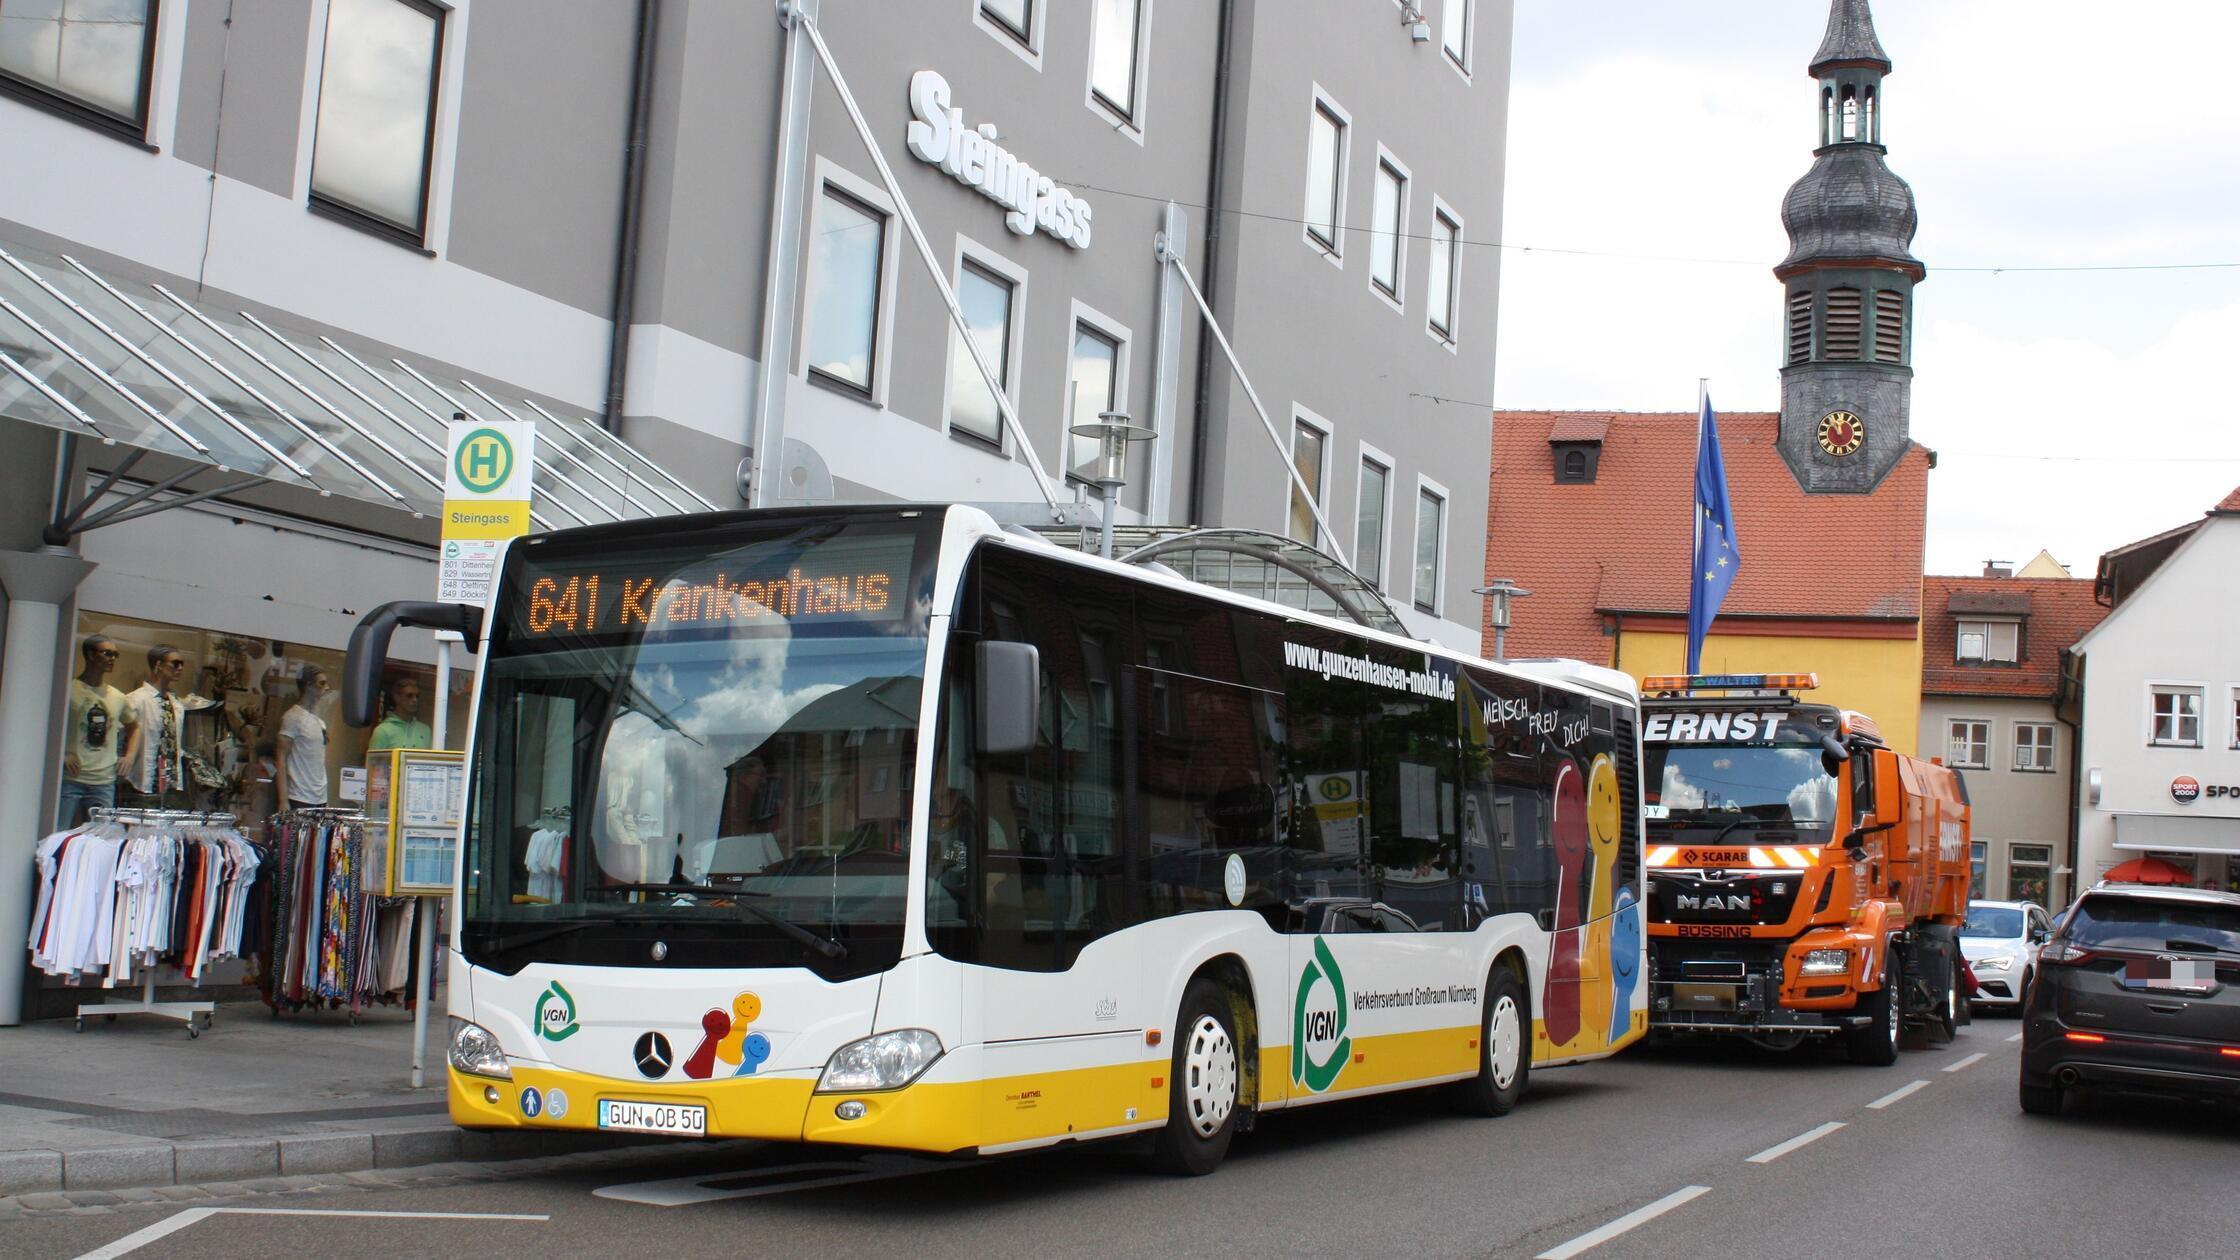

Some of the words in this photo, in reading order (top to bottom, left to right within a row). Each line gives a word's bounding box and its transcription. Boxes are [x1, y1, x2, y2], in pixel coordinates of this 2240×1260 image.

[907, 70, 1092, 249] Steingass
[469, 443, 499, 479] H
[451, 512, 510, 526] Steingass
[444, 560, 458, 569] 801
[444, 570, 458, 578] 829
[443, 581, 457, 589] 648
[443, 590, 457, 598] 649
[529, 574, 599, 632] 641
[620, 568, 891, 625] Krankenhaus
[1284, 641, 1456, 701] www.gunzenhausen-mobil.de
[1706, 676, 1760, 686] WALTER
[1483, 697, 1528, 728] MENSCH
[1563, 714, 1589, 747] DICH!
[1643, 712, 1788, 741] ERNST
[1702, 852, 1748, 862] SCARAB
[1677, 895, 1750, 910] MAN
[1678, 925, 1752, 937] BÜSSING
[1354, 986, 1414, 1010] Verkehrsverbund
[1415, 986, 1447, 1006] Großraum
[1448, 985, 1477, 1005] Nürnberg
[544, 1009, 567, 1022] VGN
[1306, 1010, 1336, 1042] VGN
[610, 1104, 643, 1126] GUN
[655, 1107, 676, 1128] OB
[681, 1109, 703, 1130] 50
